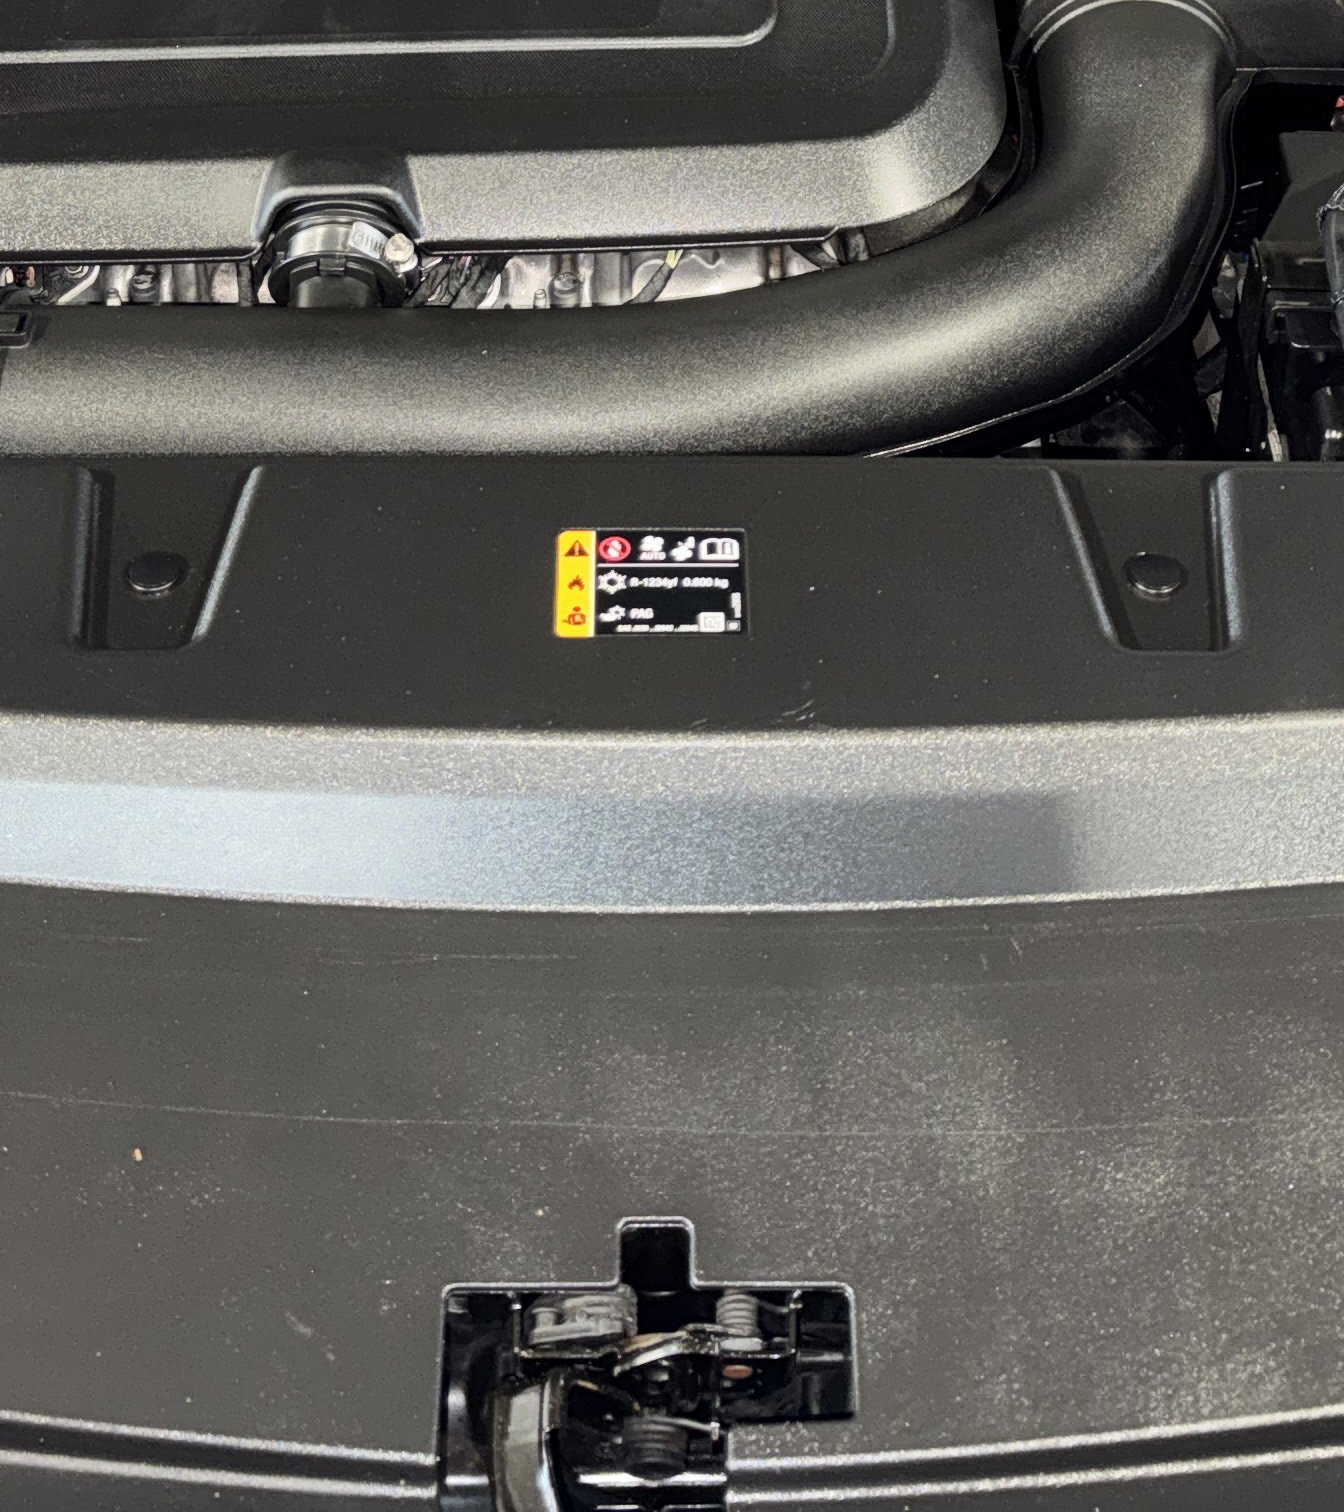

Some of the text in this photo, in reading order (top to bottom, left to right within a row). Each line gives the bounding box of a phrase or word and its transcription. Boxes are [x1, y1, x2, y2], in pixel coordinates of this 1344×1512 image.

[639, 551, 666, 561] AUTO
[714, 577, 730, 590] kg
[630, 607, 654, 620] PAG
